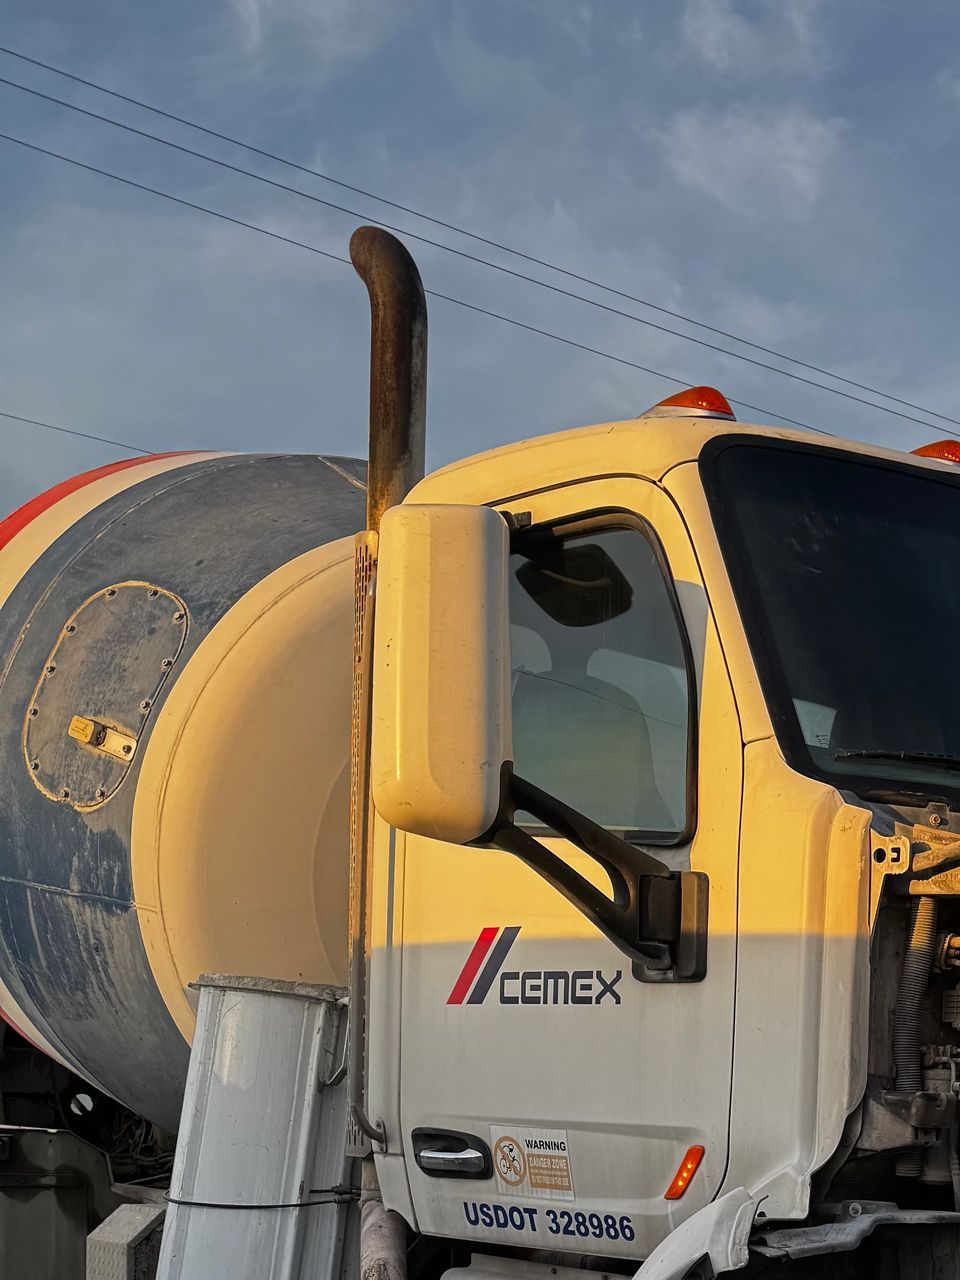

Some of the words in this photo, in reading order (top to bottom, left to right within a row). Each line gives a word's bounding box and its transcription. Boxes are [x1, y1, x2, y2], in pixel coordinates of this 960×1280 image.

[500, 970, 622, 1005] CEMEX
[525, 1139, 566, 1151] WARNING
[528, 1157, 551, 1168] DANGER
[551, 1158, 568, 1170] ZONE
[463, 1201, 538, 1232] USDOT
[547, 1208, 636, 1242] 328986
